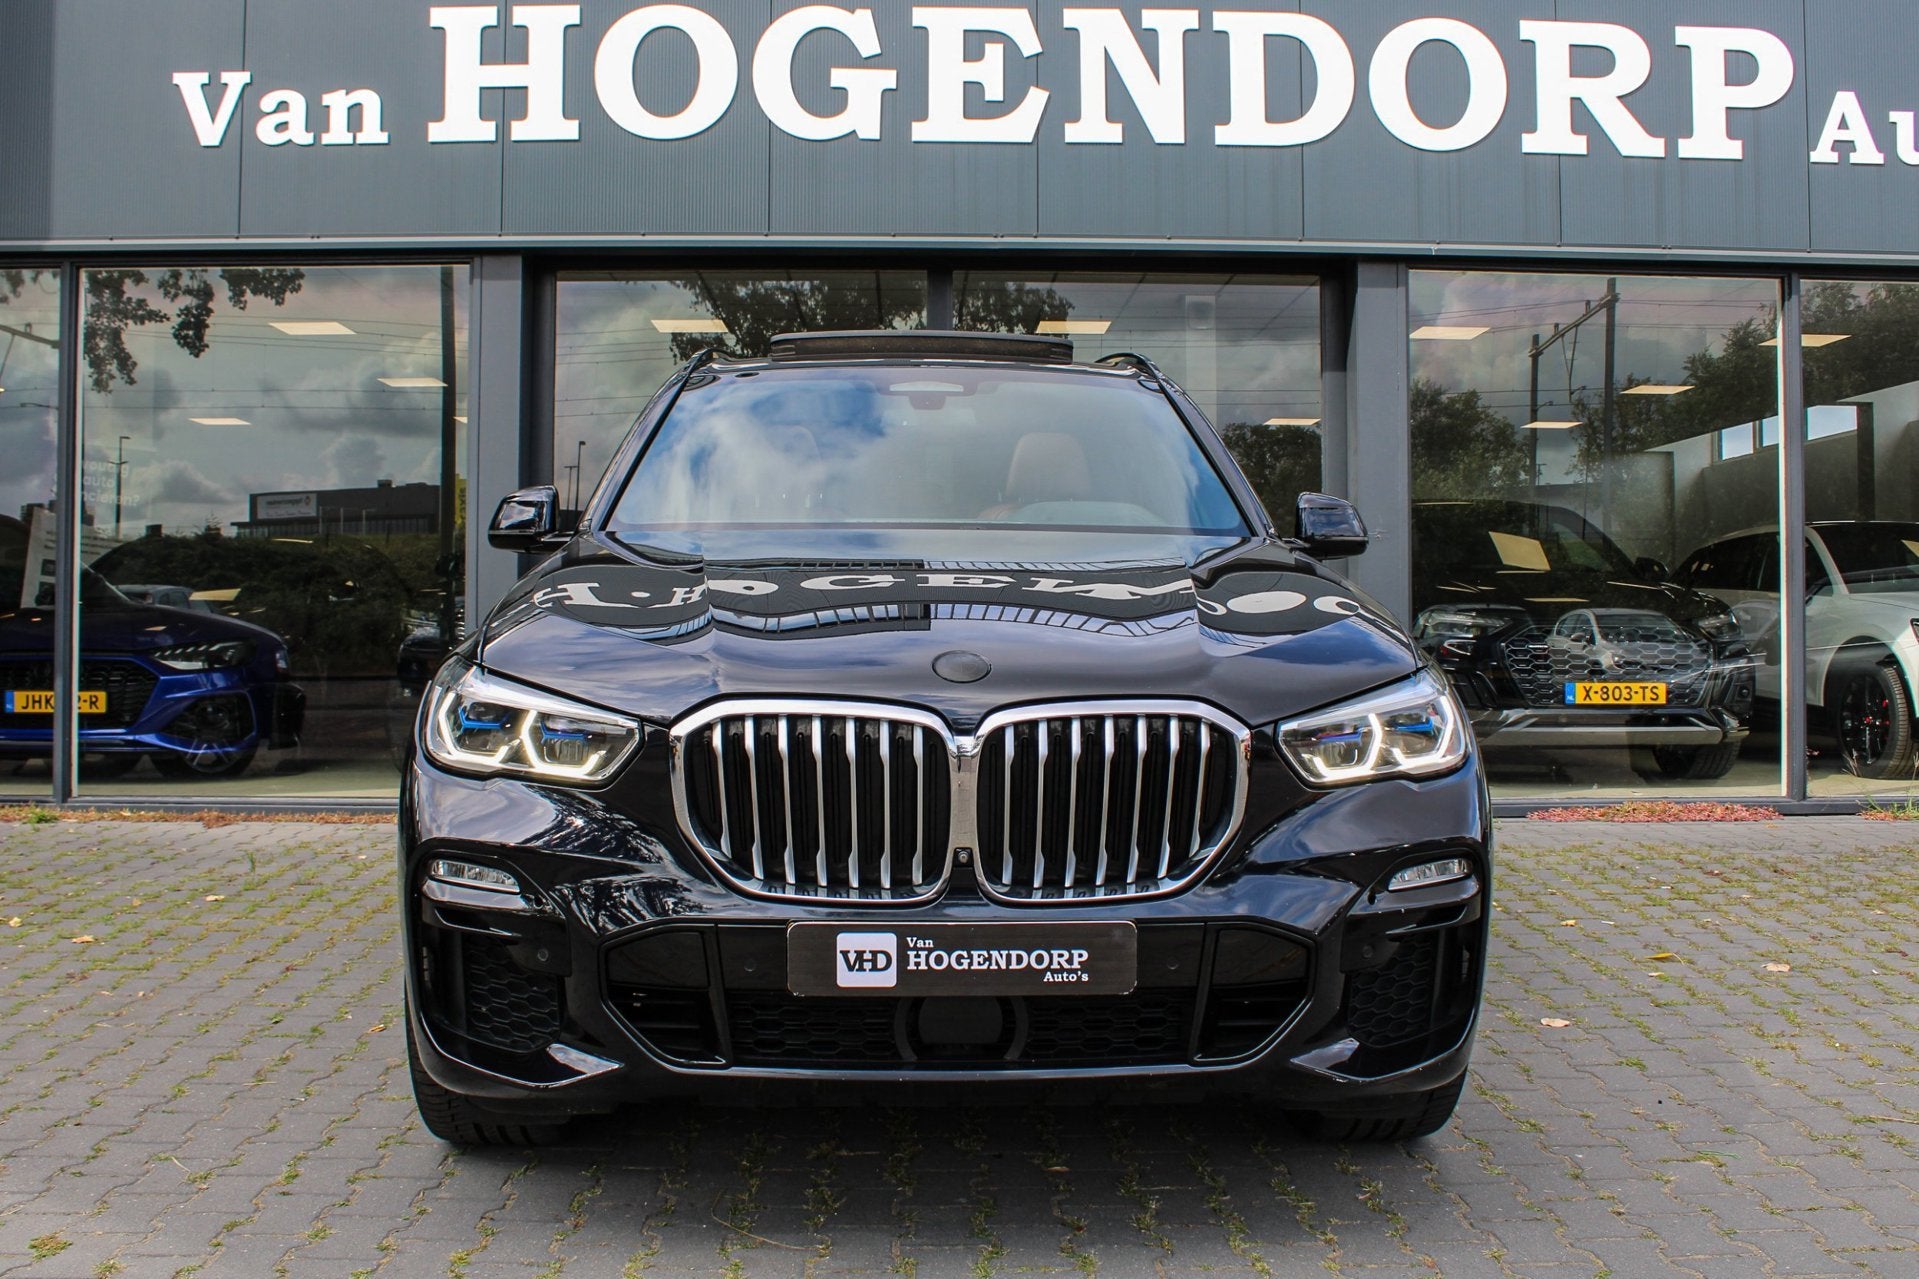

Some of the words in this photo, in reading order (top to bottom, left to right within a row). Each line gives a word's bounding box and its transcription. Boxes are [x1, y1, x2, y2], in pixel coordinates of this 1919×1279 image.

[172, 71, 389, 148] Van
[427, 4, 1794, 160] HOGENDORP
[21, 694, 99, 710] JHK-R
[1583, 685, 1660, 702] X-803-TS
[906, 936, 934, 948] Van
[839, 950, 893, 972] VHD
[907, 950, 1089, 970] HOGENDORP
[1043, 971, 1089, 983] Auto's
